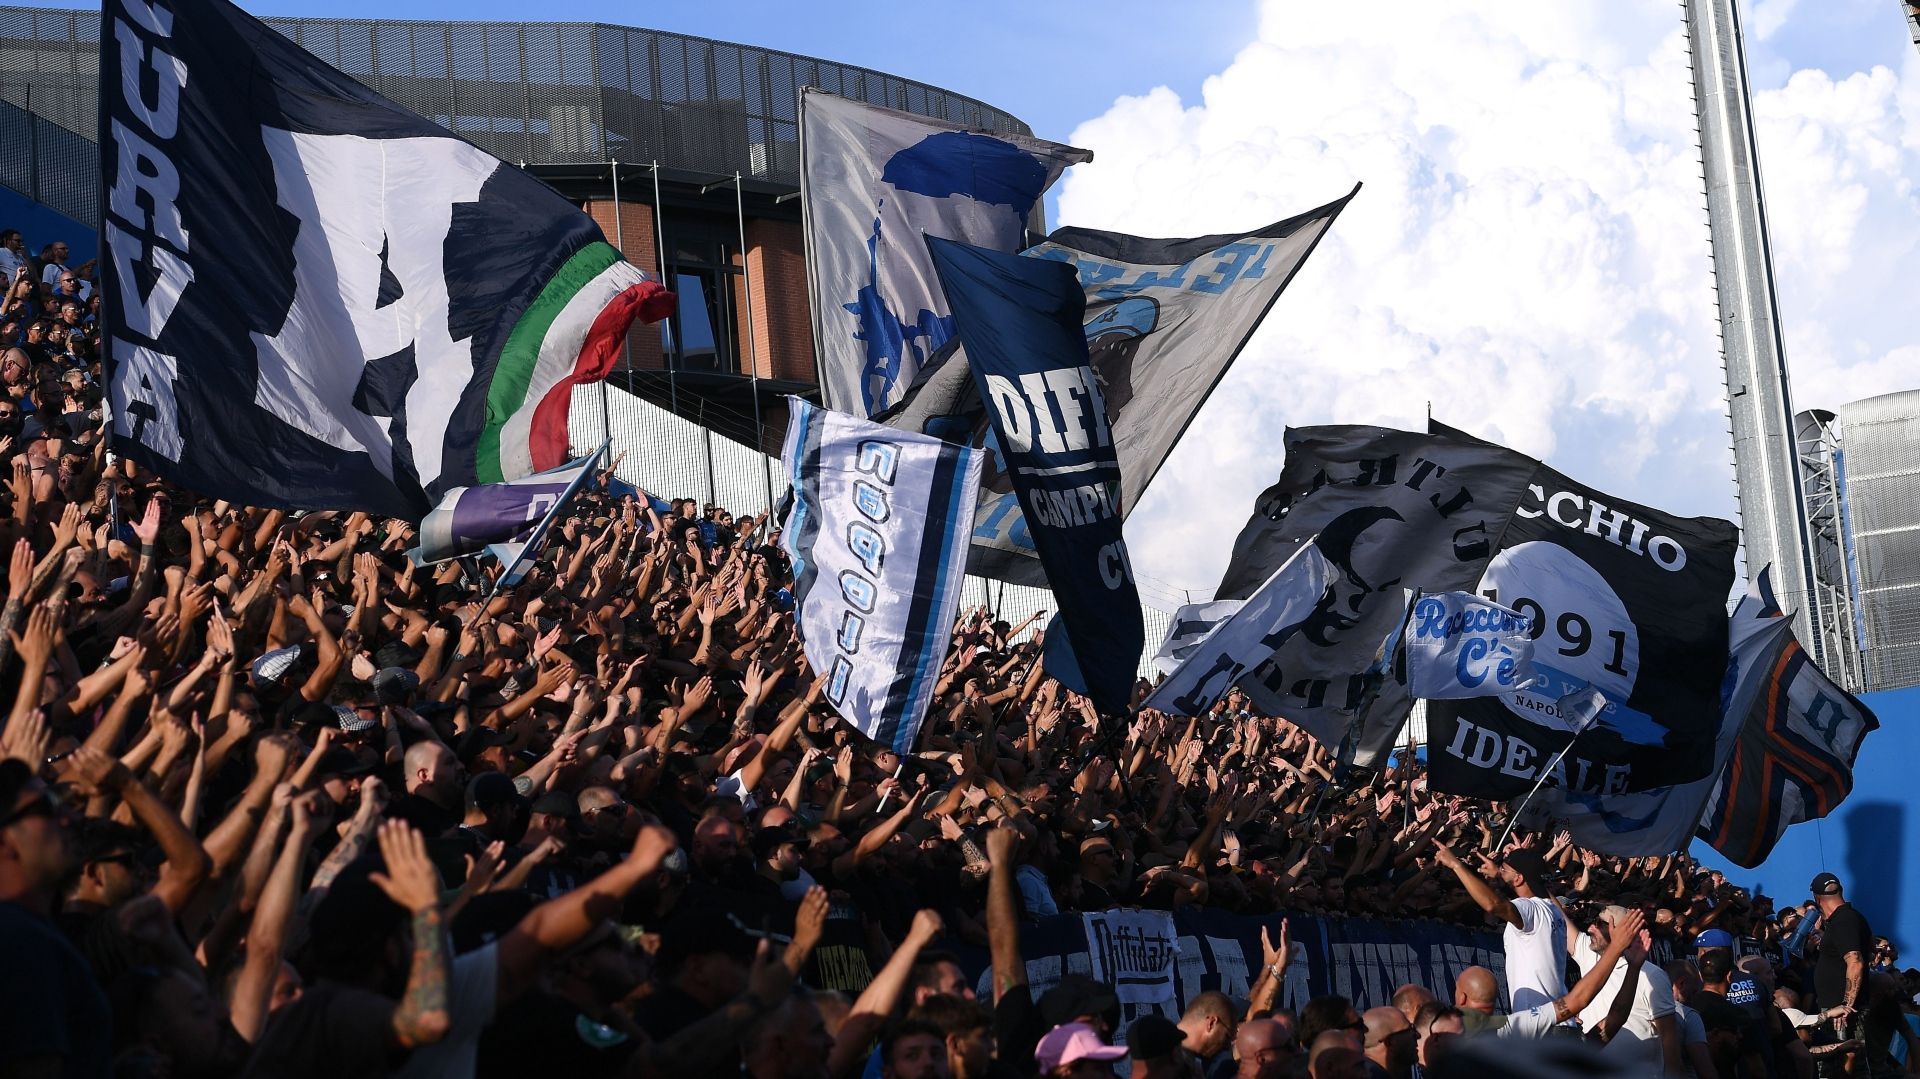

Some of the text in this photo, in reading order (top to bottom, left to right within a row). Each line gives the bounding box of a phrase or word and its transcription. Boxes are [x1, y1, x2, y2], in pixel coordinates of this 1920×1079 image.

[1515, 694, 1564, 719] NAPOL
[1445, 716, 1632, 798] IDEALE
[1729, 979, 1756, 992] ORE
